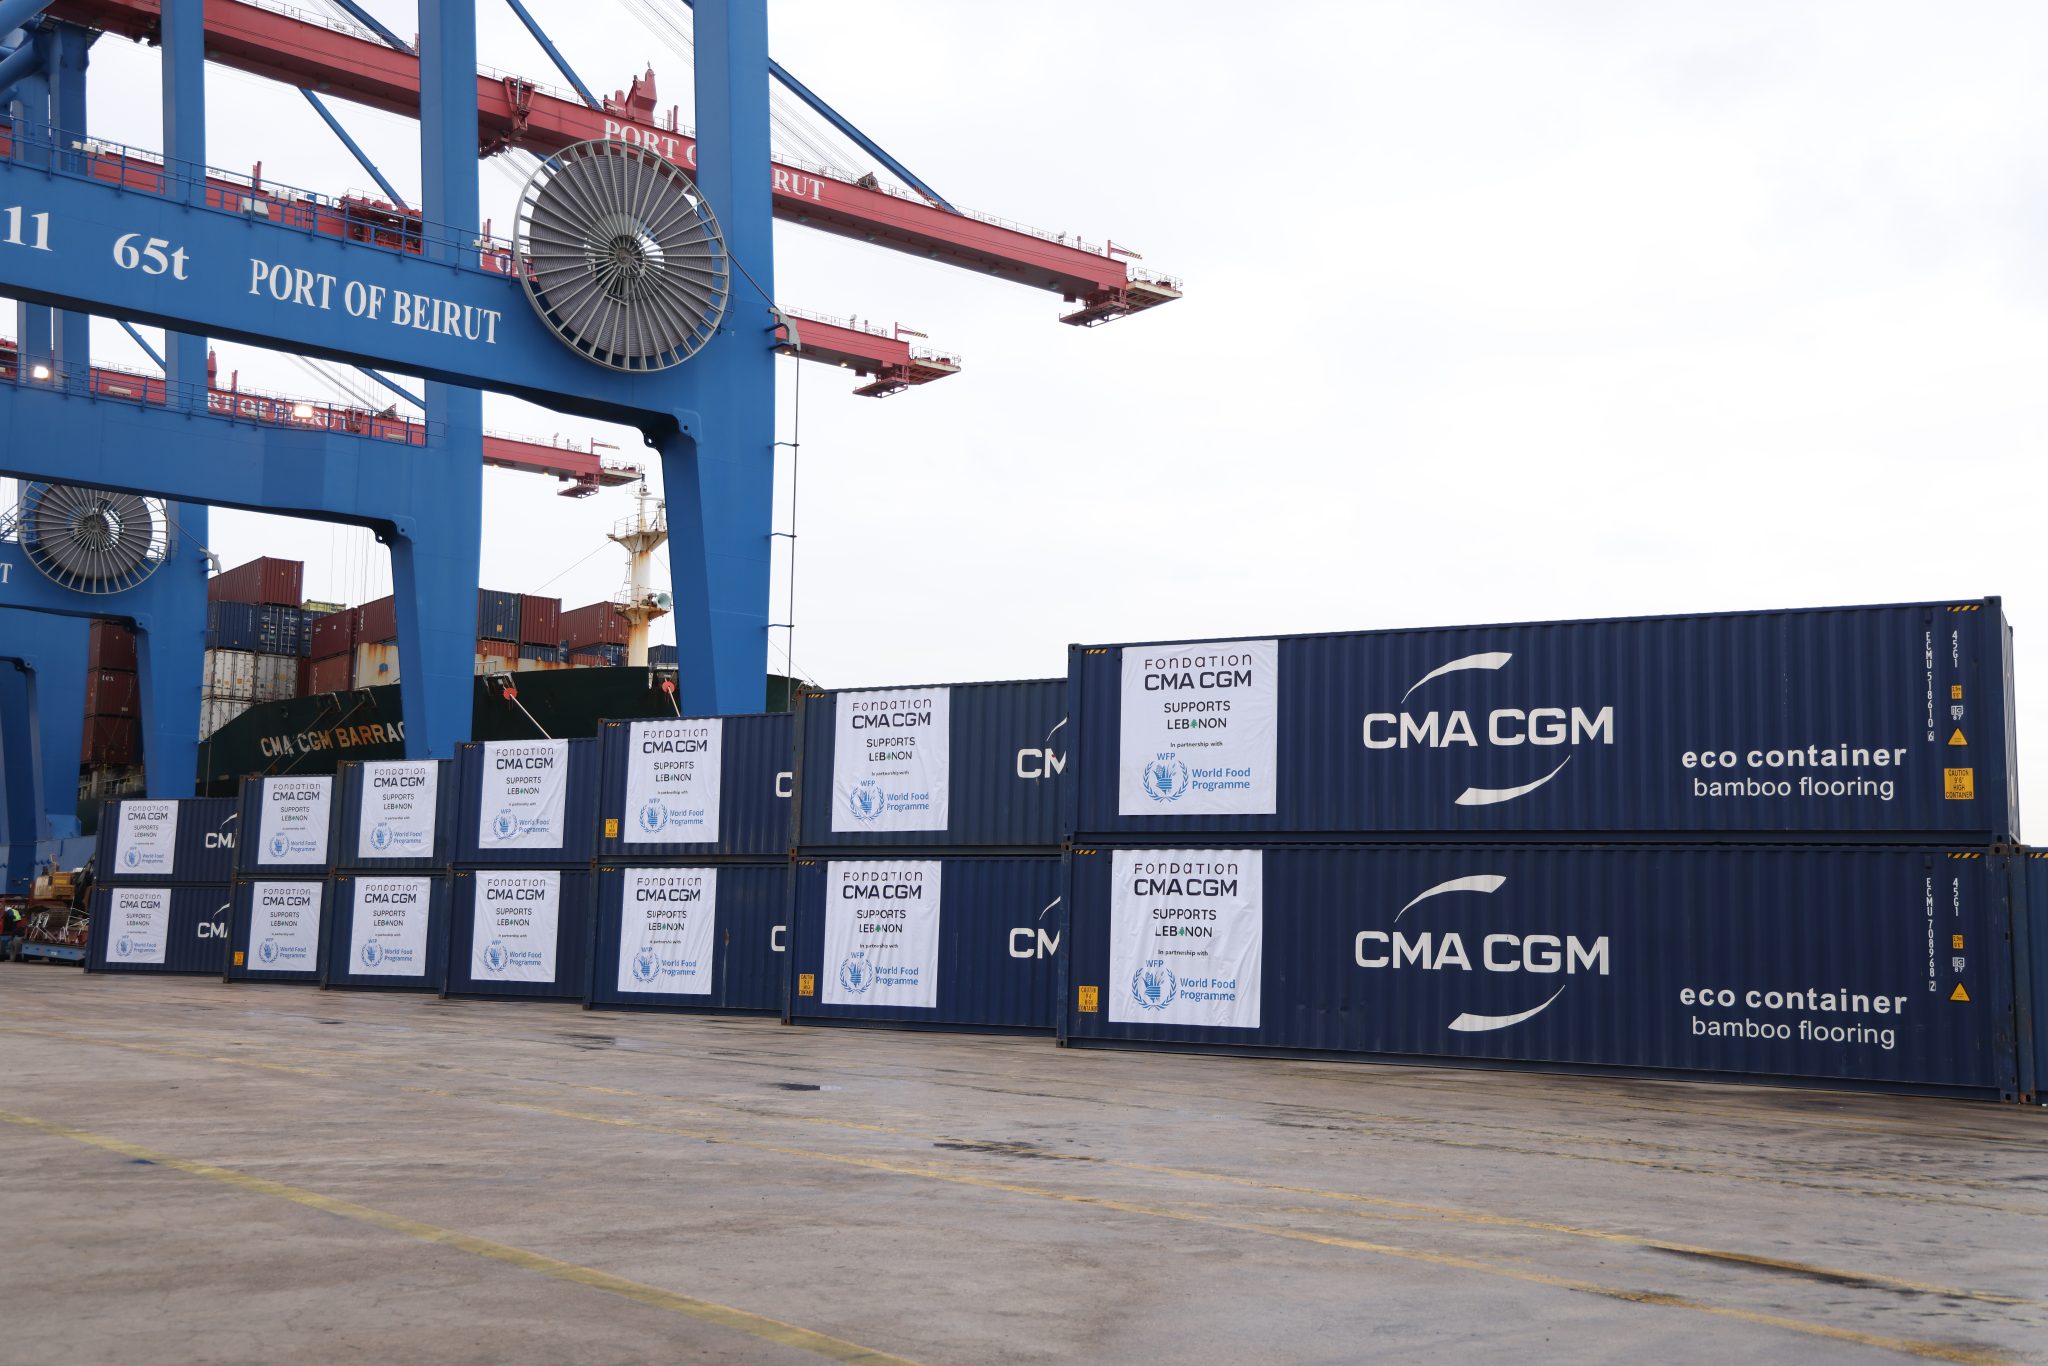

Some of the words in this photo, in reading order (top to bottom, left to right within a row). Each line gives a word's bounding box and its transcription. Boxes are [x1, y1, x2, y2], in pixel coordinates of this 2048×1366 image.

[604, 119, 679, 160] PORT
[772, 169, 825, 201] RUT
[3, 206, 53, 251] 11
[113, 233, 190, 280] 65t
[249, 258, 336, 310] PORT
[344, 281, 386, 319] OF
[393, 290, 501, 344] BEIRUT
[1145, 673, 1194, 690] CMA
[1200, 670, 1251, 688] CGM
[1164, 701, 1230, 713] SUPPORTS
[853, 714, 889, 728] CMA
[893, 712, 930, 726] CGM
[1363, 710, 1478, 749] CMA
[1488, 706, 1614, 747] CGM
[261, 735, 294, 757] CMA
[297, 729, 333, 753] CGM
[643, 740, 673, 752] CMA
[676, 739, 706, 751] CGM
[867, 736, 915, 747] SUPPORTS
[1681, 750, 1737, 768] eco
[1746, 743, 1907, 768] container
[496, 759, 523, 769] CMA
[526, 758, 553, 768] CGM
[654, 760, 693, 769] SUPPORTS
[1017, 748, 1066, 779] CM
[1192, 768, 1222, 777] World
[1226, 768, 1250, 777] Food
[374, 778, 398, 787] CMA
[400, 777, 425, 786] CGM
[1192, 780, 1250, 791] Programme
[1694, 777, 1791, 798] bamboo
[1799, 776, 1895, 801] flooring
[273, 792, 295, 800] CMA
[297, 791, 320, 800] CGM
[886, 792, 908, 800] World
[911, 791, 929, 799] Food
[886, 802, 928, 811] Programme
[668, 818, 703, 826] Programme
[844, 884, 880, 898] CMA
[884, 884, 921, 899] CGM
[1134, 878, 1182, 895] CMA
[1188, 879, 1236, 896] CGM
[365, 893, 390, 903] CMA
[392, 893, 417, 903] CGM
[488, 889, 515, 900] CMA
[518, 889, 545, 900] CGM
[637, 888, 667, 900] CMA
[670, 888, 700, 900] CGM
[263, 897, 285, 905] CMA
[287, 897, 310, 906] CGM
[647, 910, 687, 918] SUPPORTS
[857, 909, 905, 918] SUPPORTS
[1153, 909, 1216, 920] SUPPORTS
[1009, 928, 1061, 959] CM
[1355, 931, 1473, 971] CMA
[1483, 934, 1609, 976] CGM
[1146, 960, 1163, 968] WFP
[662, 968, 696, 976] Programme
[876, 966, 898, 974] World
[876, 977, 918, 986] Programme
[1180, 978, 1208, 988] World
[1212, 979, 1235, 988] Food
[1180, 991, 1235, 1001] Programme
[1680, 988, 1736, 1007] eco
[1746, 988, 1907, 1014] container
[1692, 1016, 1791, 1040] bamboo
[1798, 1020, 1896, 1049] flooring
